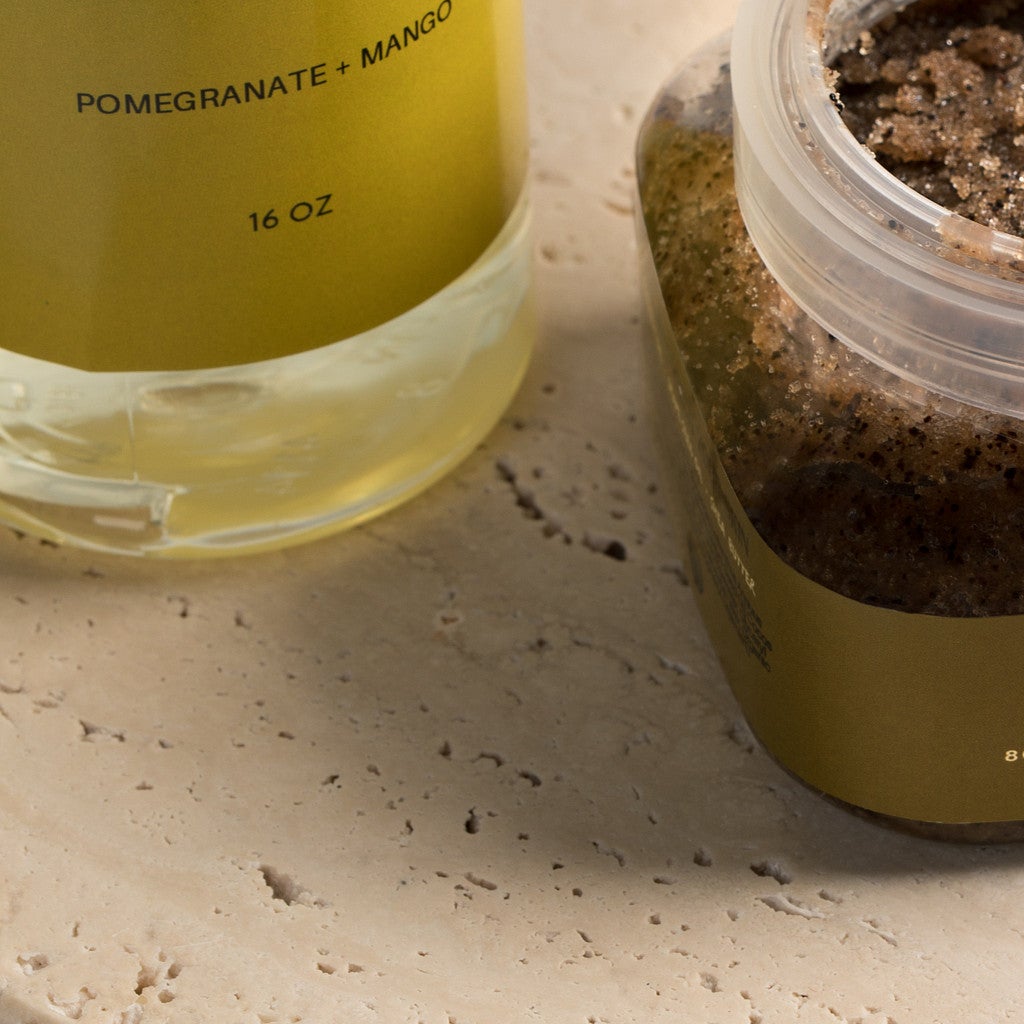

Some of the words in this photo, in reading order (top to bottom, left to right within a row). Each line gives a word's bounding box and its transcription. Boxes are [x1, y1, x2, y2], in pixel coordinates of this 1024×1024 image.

[77, 63, 327, 114] POMEGRANATE
[249, 209, 279, 232] 16
[290, 194, 334, 222] OZ
